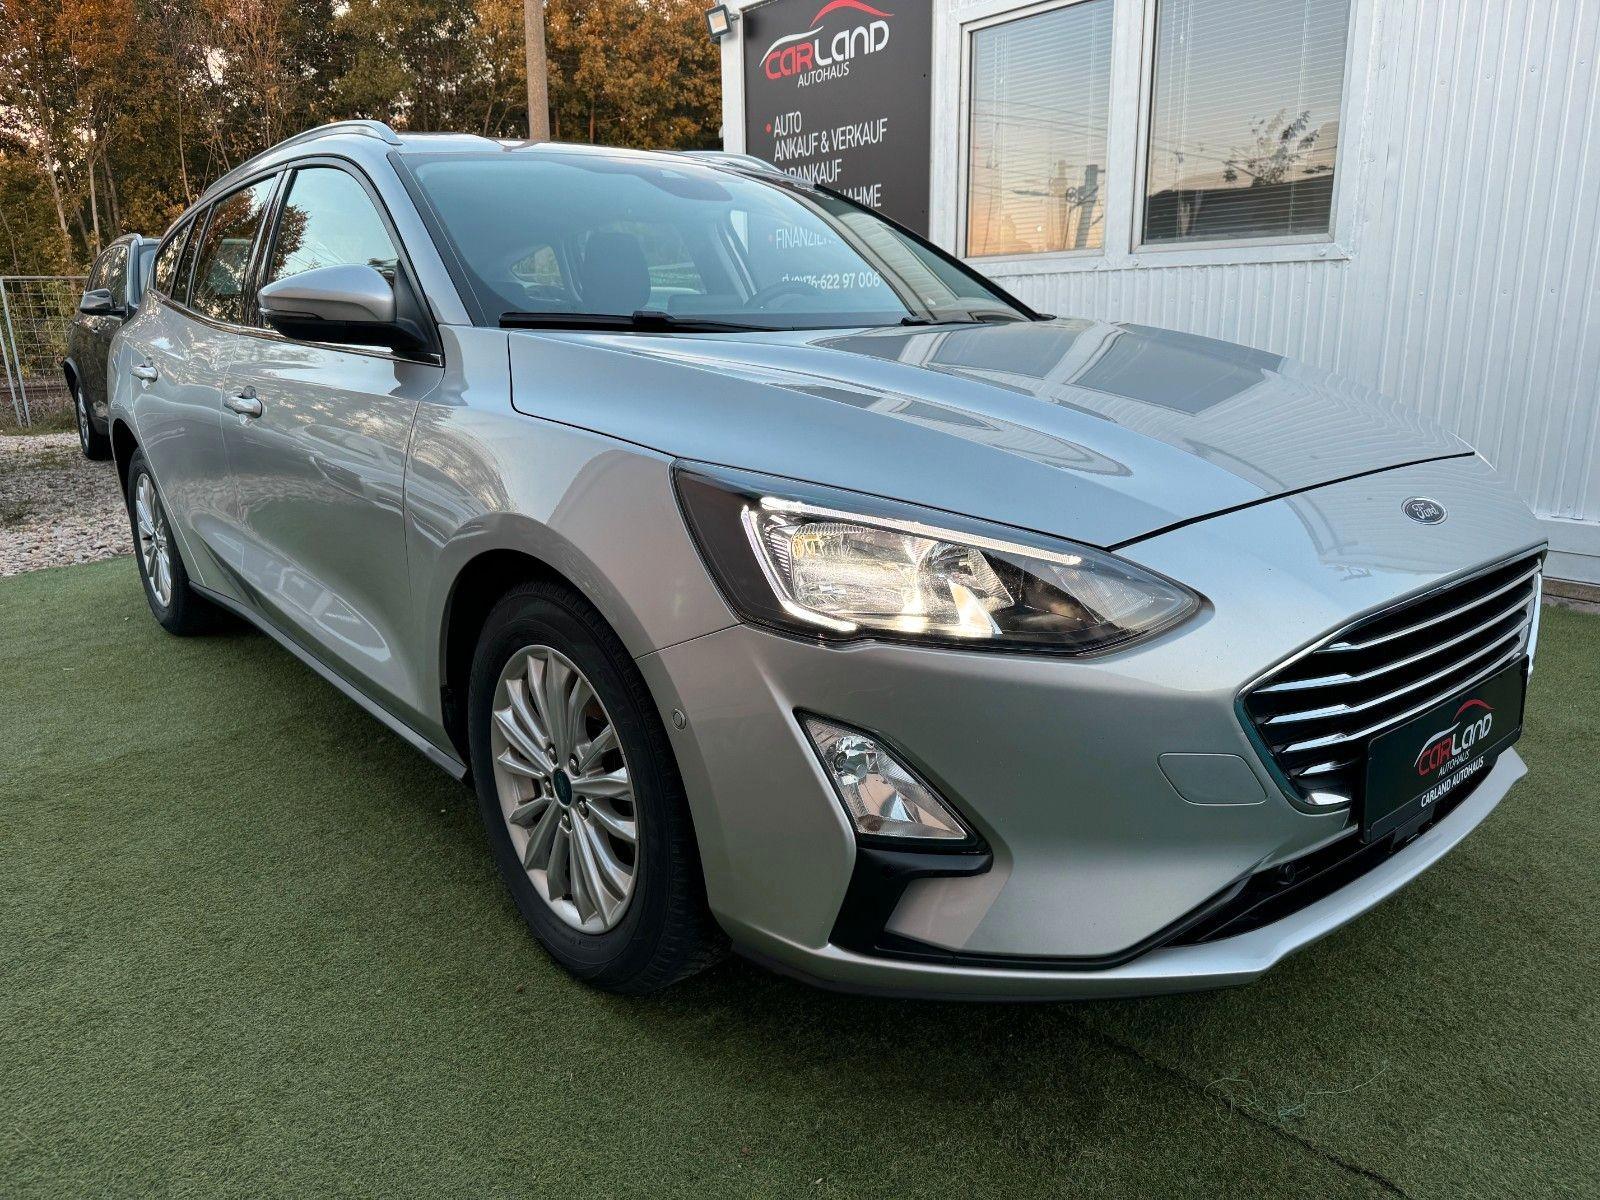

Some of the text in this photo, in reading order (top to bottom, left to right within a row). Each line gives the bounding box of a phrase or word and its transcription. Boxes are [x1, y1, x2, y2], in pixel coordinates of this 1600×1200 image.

[797, 62, 850, 88] AUTOHAUS
[773, 111, 802, 138] AUTO
[774, 118, 888, 162] ANKAUF & VERKAUF
[842, 273, 856, 289] 97
[1438, 749, 1471, 777] AUTOHAUS
[1421, 756, 1484, 808] CARLAND AUTOHAUS
